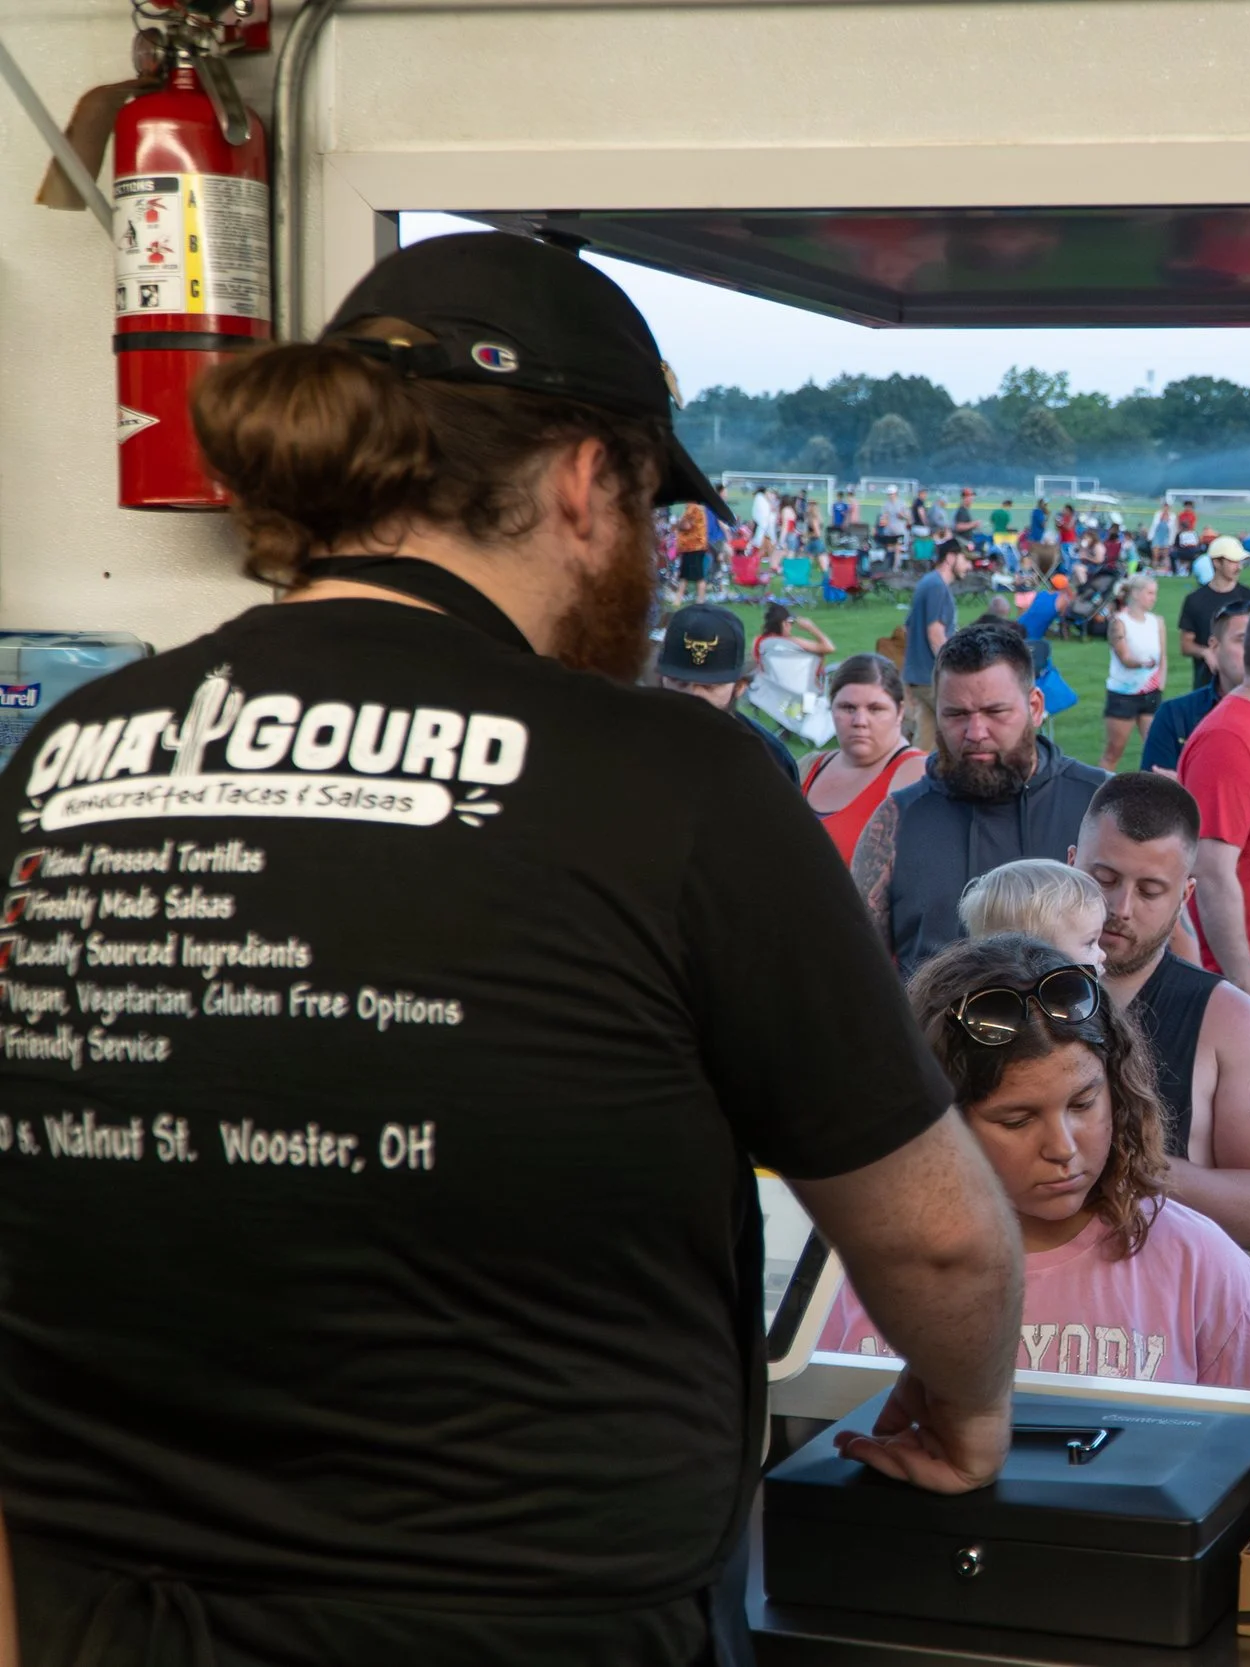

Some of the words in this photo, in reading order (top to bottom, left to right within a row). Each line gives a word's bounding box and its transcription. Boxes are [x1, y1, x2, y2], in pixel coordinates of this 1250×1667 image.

[187, 189, 198, 209] A
[189, 234, 198, 253] B
[190, 279, 200, 298] C
[0, 687, 38, 706] urell
[225, 693, 529, 785] GOURD
[216, 782, 288, 805] Tacos
[316, 784, 414, 812] Salsas
[41, 844, 91, 877] Hand
[91, 839, 174, 875] Pressed
[177, 838, 266, 872] Tortillas
[26, 886, 97, 930] Freshly
[99, 884, 159, 919] Made
[165, 883, 236, 919] Salsas
[16, 930, 83, 977] Locally
[86, 931, 178, 967] Sourced
[182, 930, 313, 980] Ingredients
[76, 981, 197, 1025] Vegetarian,
[202, 980, 282, 1018] Gluten
[289, 982, 350, 1019] Free
[356, 985, 464, 1032] Options
[5, 1023, 84, 1071] Friendly
[88, 1025, 172, 1063] Service
[44, 1111, 144, 1161] Walnut
[152, 1113, 198, 1163] St.
[220, 1117, 367, 1174] Wooster,
[379, 1120, 436, 1170] OH
